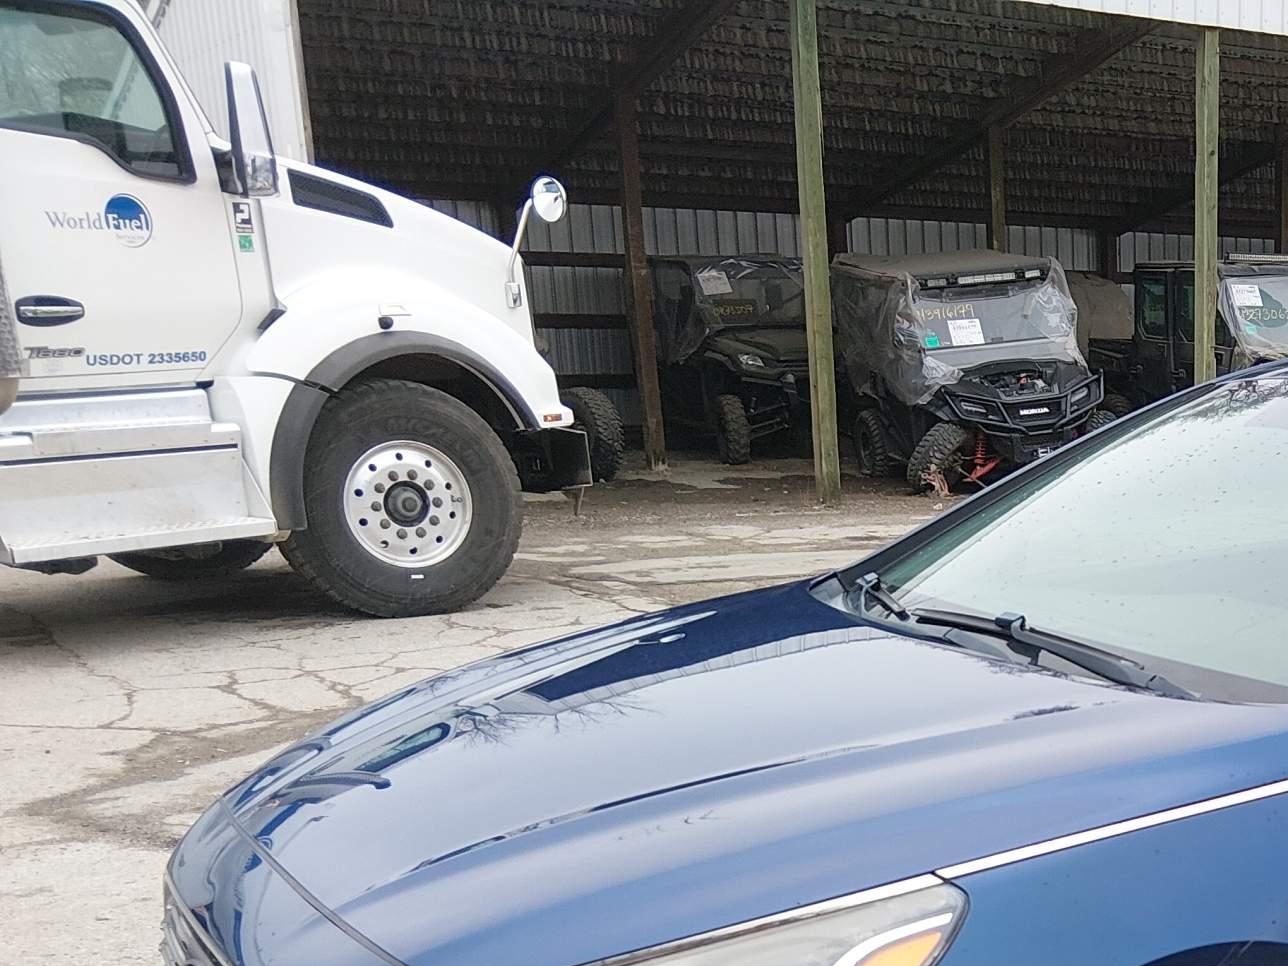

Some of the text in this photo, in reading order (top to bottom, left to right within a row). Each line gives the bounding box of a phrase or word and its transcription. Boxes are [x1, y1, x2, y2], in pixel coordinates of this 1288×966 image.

[44, 210, 151, 232] World Fuel
[86, 350, 207, 367] USDOT 2335650
